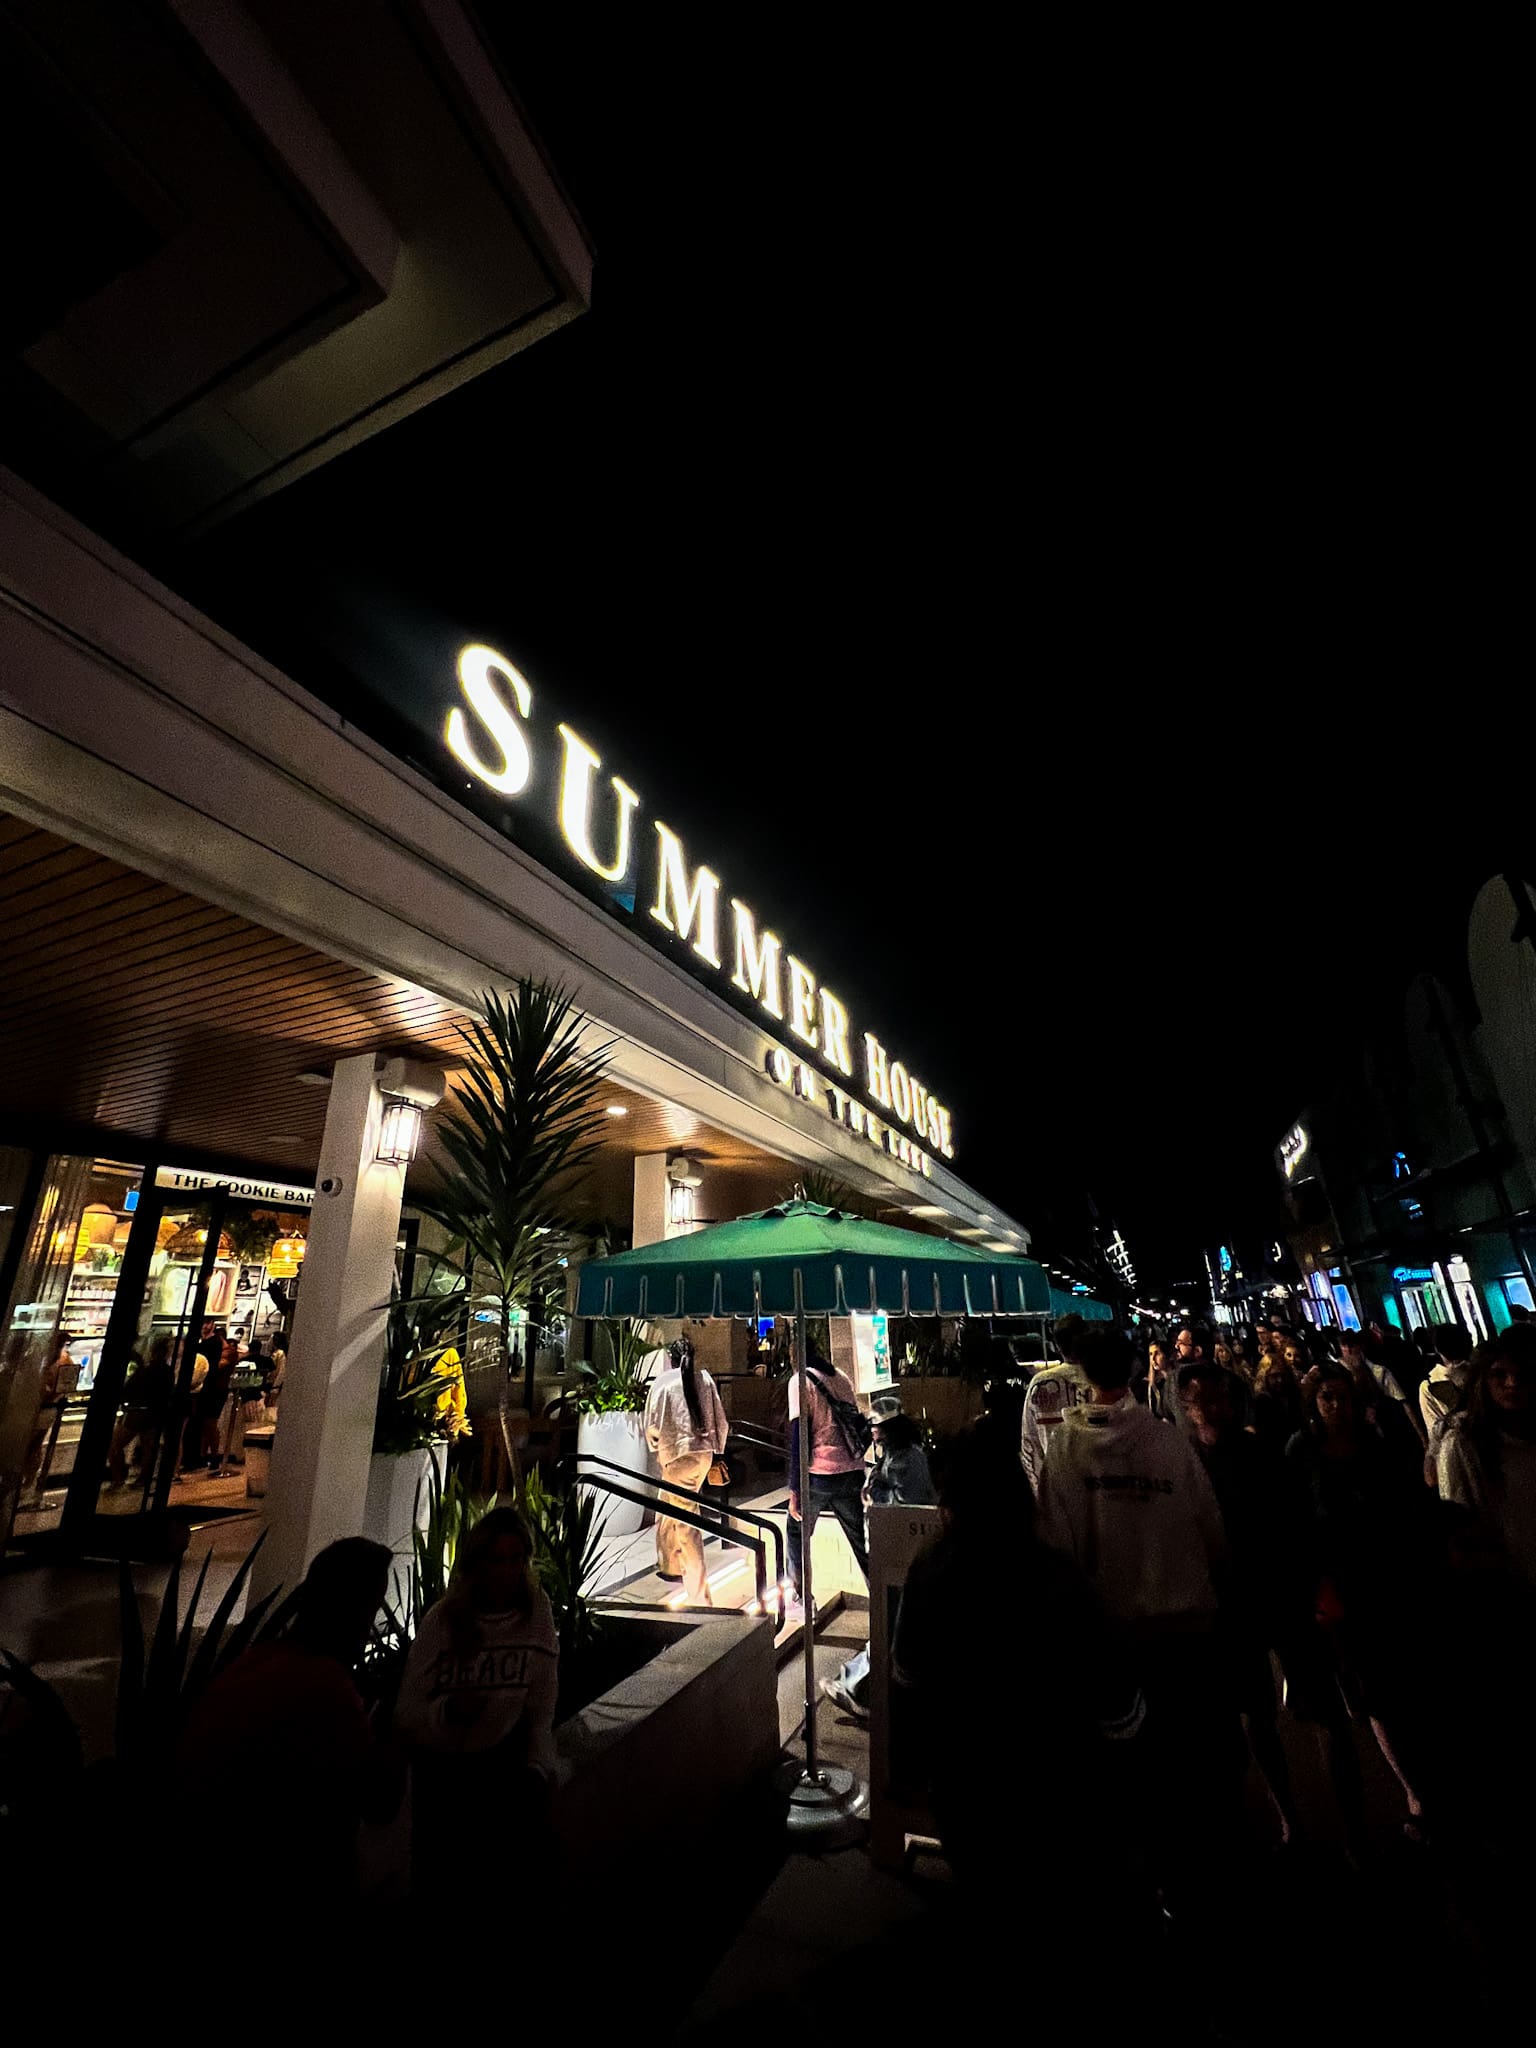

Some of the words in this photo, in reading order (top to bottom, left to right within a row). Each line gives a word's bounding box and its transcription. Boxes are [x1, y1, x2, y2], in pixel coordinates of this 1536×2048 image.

[444, 644, 852, 1077] SUMMER
[863, 1032, 955, 1159] HOUSE
[766, 1047, 816, 1101] ON
[827, 1087, 882, 1147] THE
[173, 1173, 211, 1190] THE
